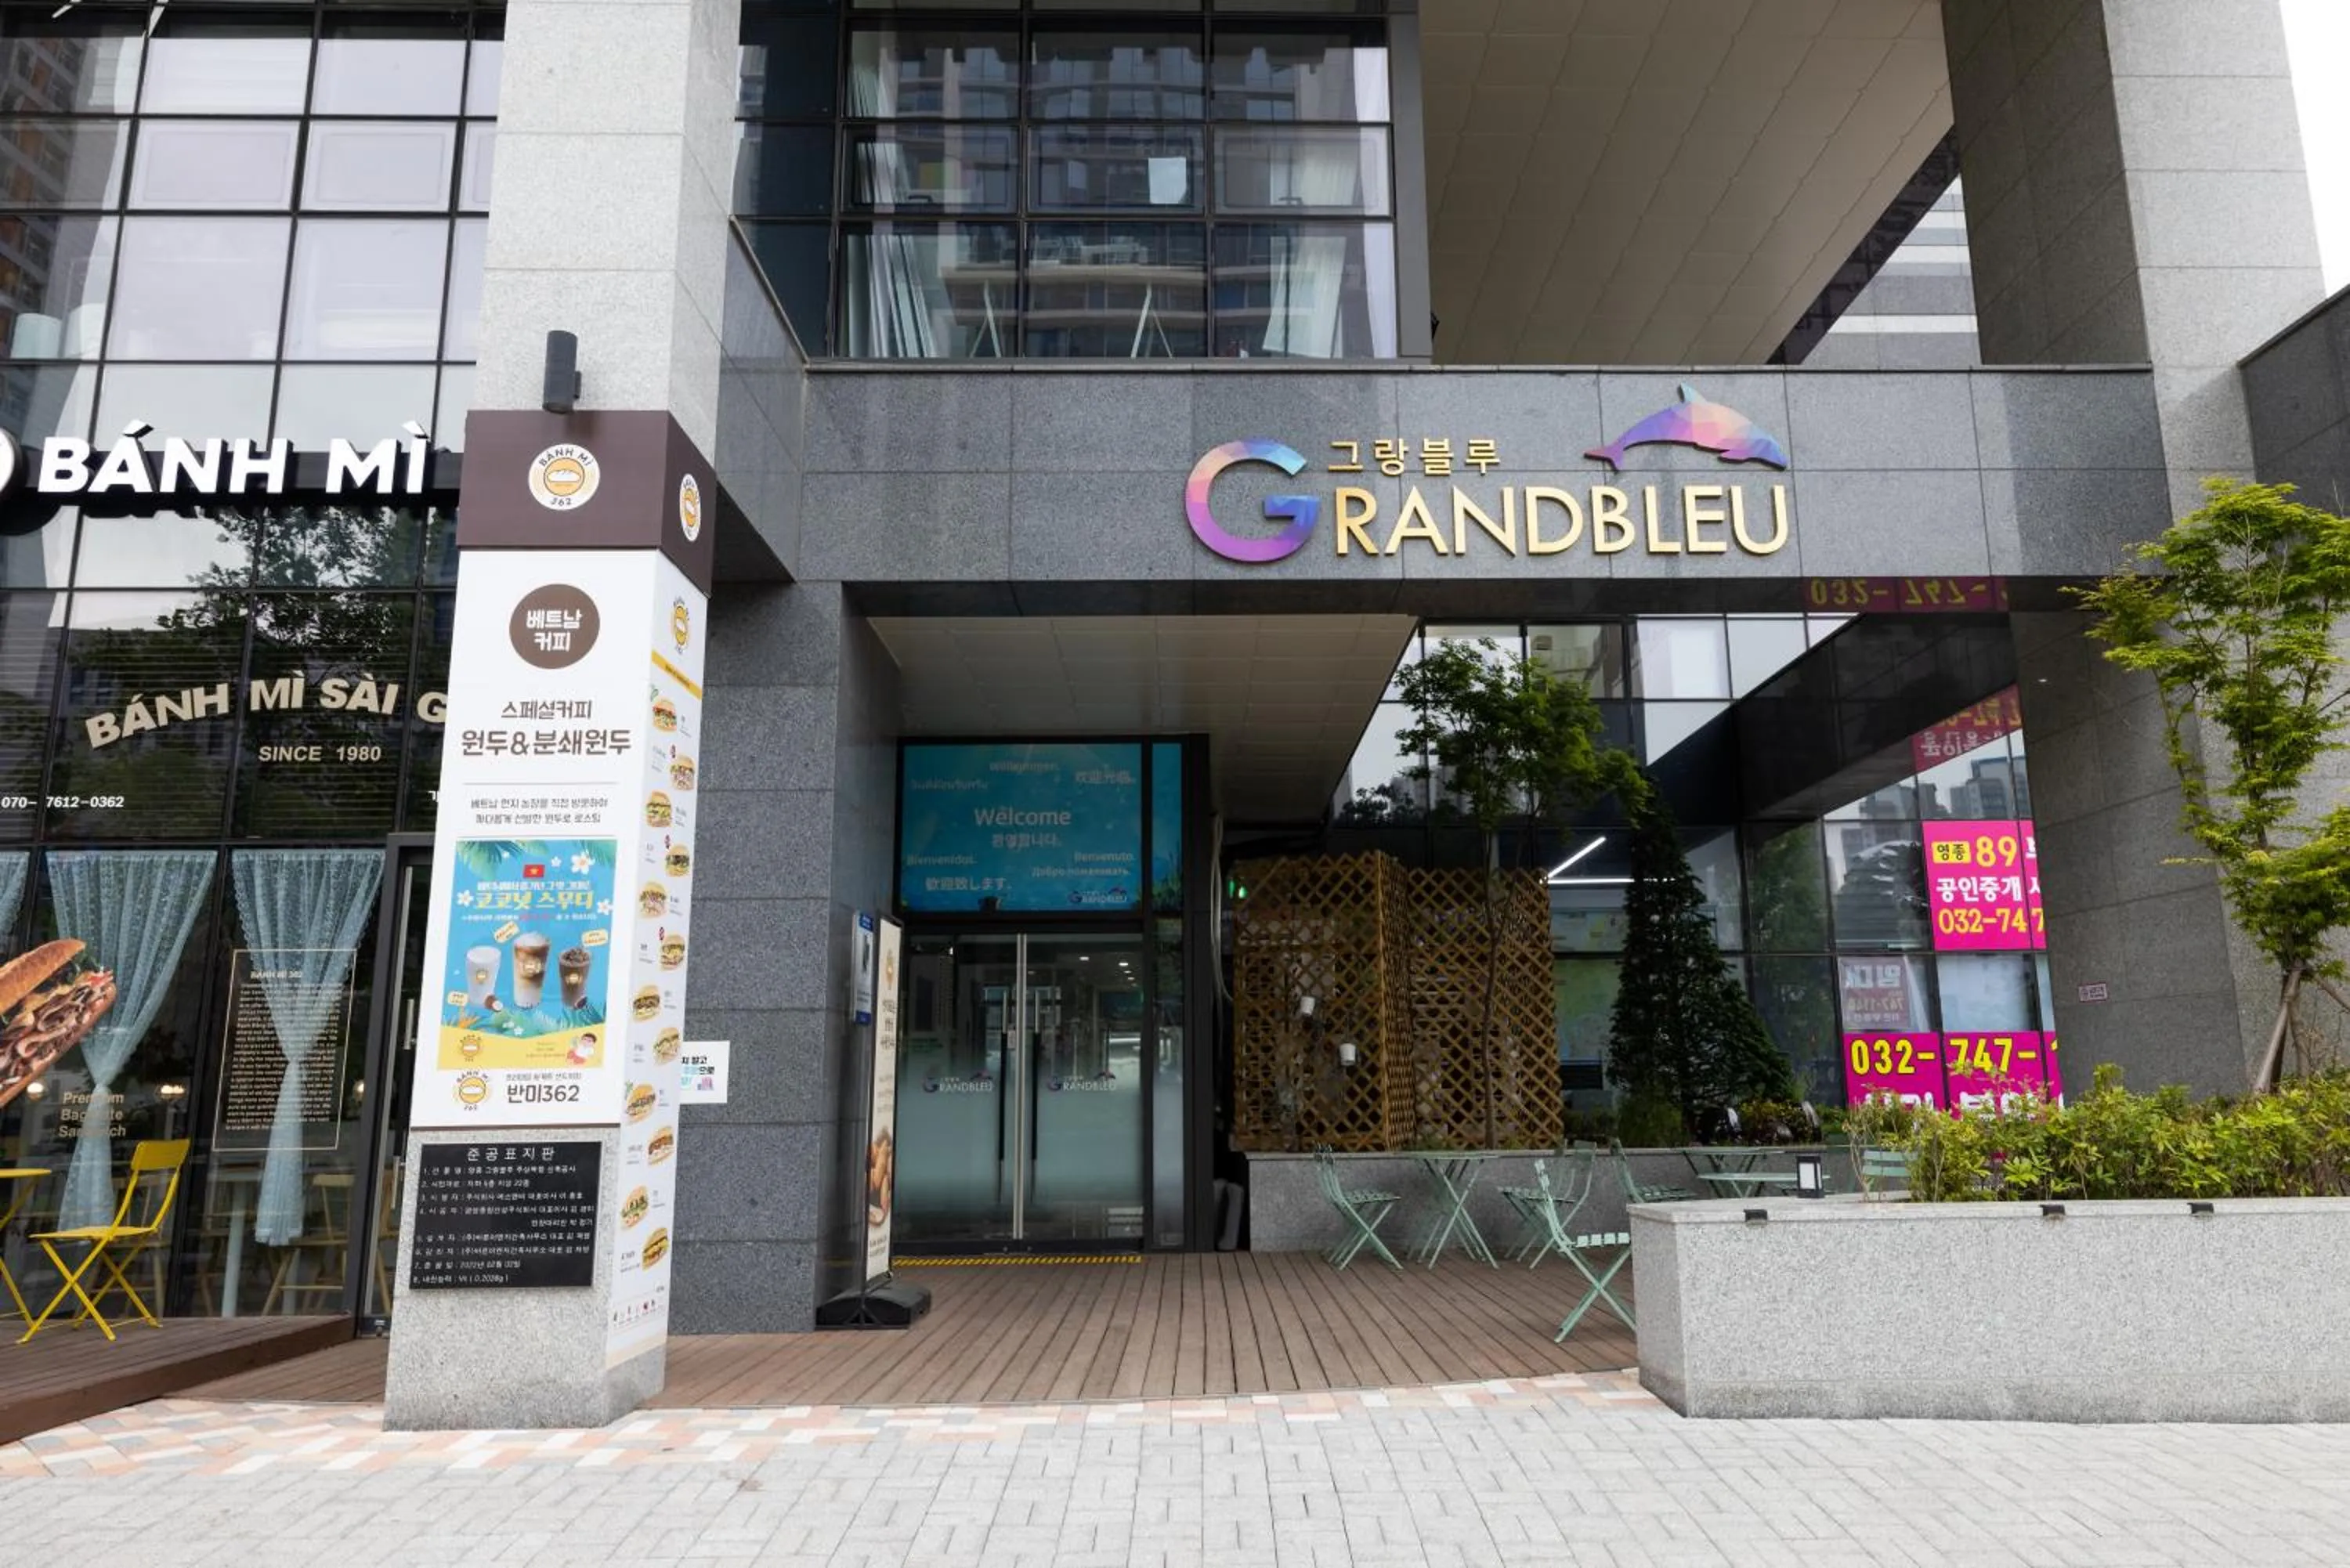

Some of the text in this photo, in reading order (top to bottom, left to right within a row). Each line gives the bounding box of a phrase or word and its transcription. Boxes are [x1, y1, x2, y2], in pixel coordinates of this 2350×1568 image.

[38, 420, 429, 494] BÁNH MÌ
[1328, 437, 1501, 476] 그랑블루
[551, 497, 572, 507] 362
[1185, 437, 1790, 562] GRANDBLEU
[526, 609, 582, 630] 베트남
[534, 631, 571, 652] 커피
[85, 682, 230, 749] BÁNH
[251, 670, 306, 711] MÌ
[320, 674, 399, 715] SÀI
[501, 699, 592, 720] 스페셜커피
[461, 729, 631, 756] 원두&분쇄원두
[258, 746, 381, 762] SINCE 1980
[46, 796, 124, 808] 7612-0362
[974, 807, 1072, 826] Welcome
[1936, 843, 1965, 861] 영종
[1976, 836, 2017, 868] 89
[1851, 1038, 2037, 1075] 032- 747-
[508, 1083, 580, 1104] 반미362
